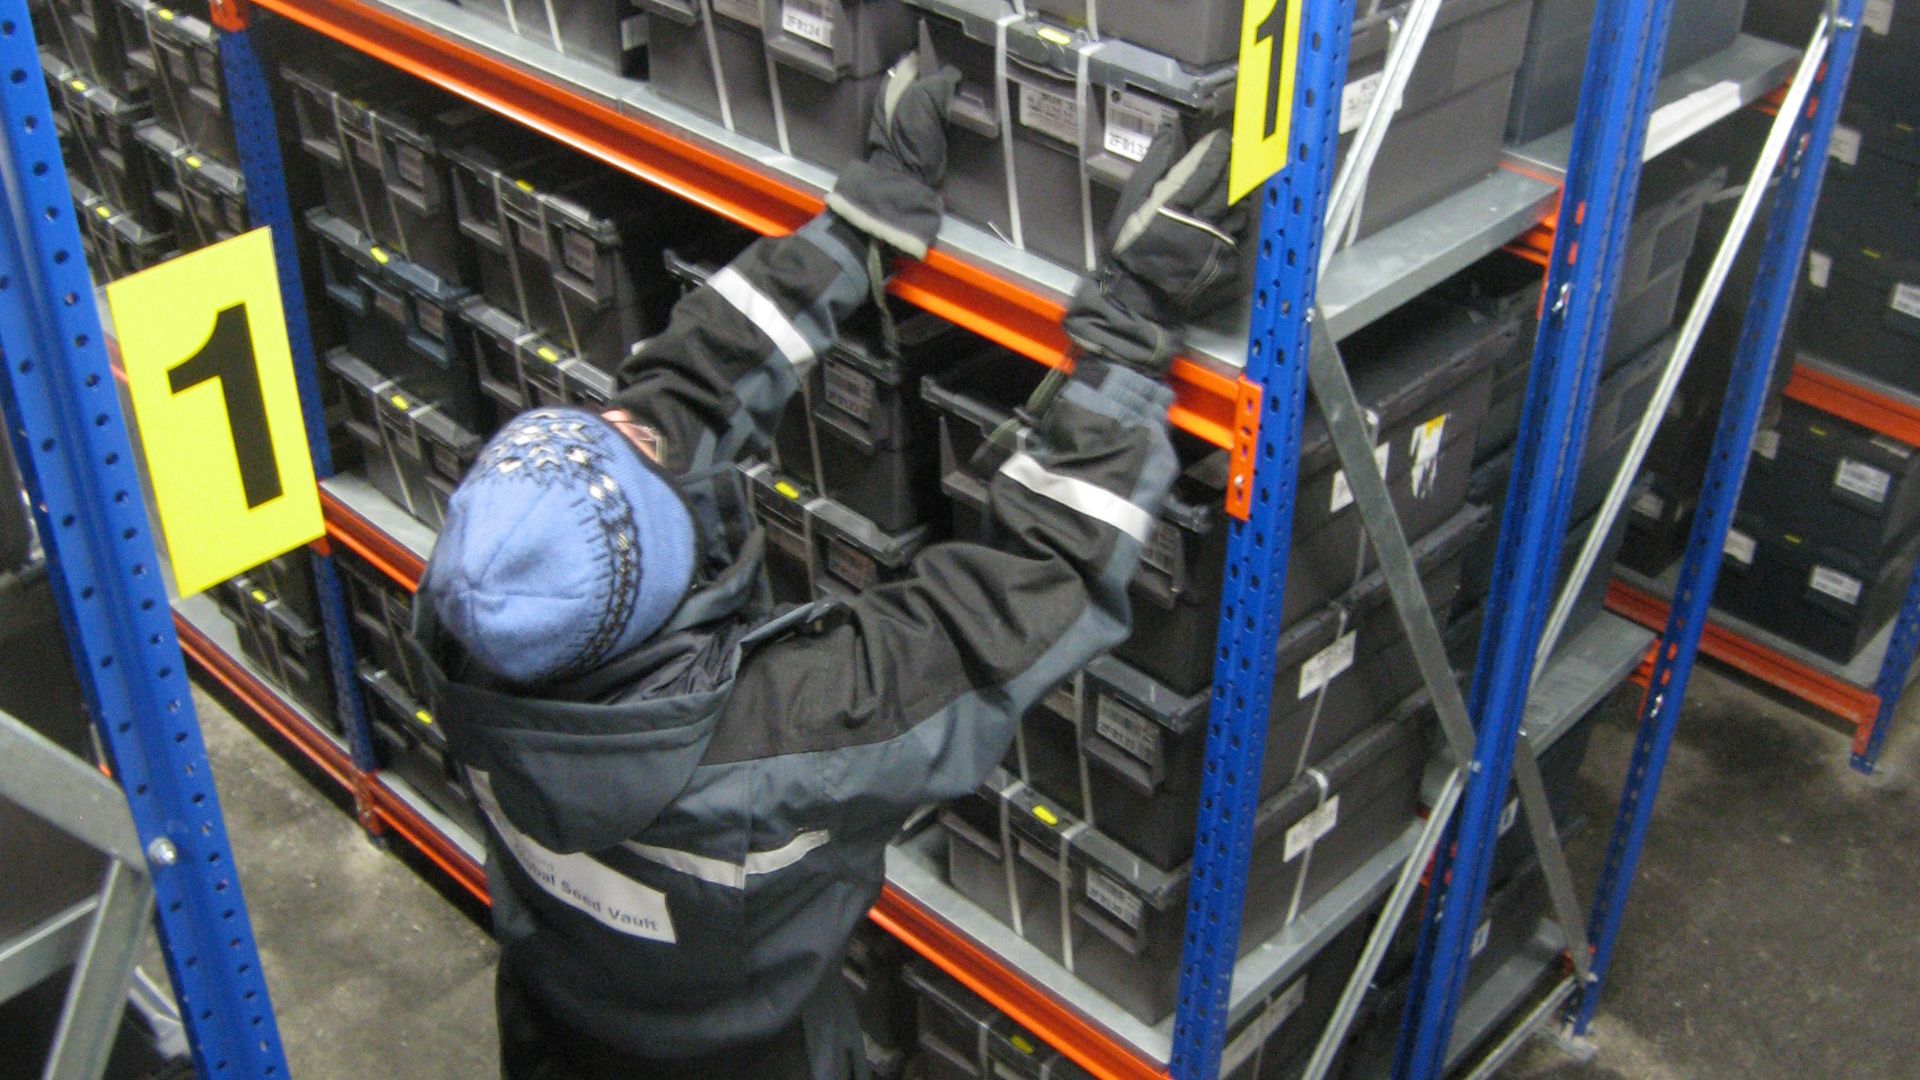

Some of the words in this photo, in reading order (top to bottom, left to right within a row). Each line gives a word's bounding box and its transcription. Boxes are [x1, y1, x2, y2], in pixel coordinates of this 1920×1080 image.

[1256, 0, 1288, 139] 1
[168, 302, 282, 508] 1
[561, 881, 601, 913] Seed
[608, 908, 659, 932] Vault
